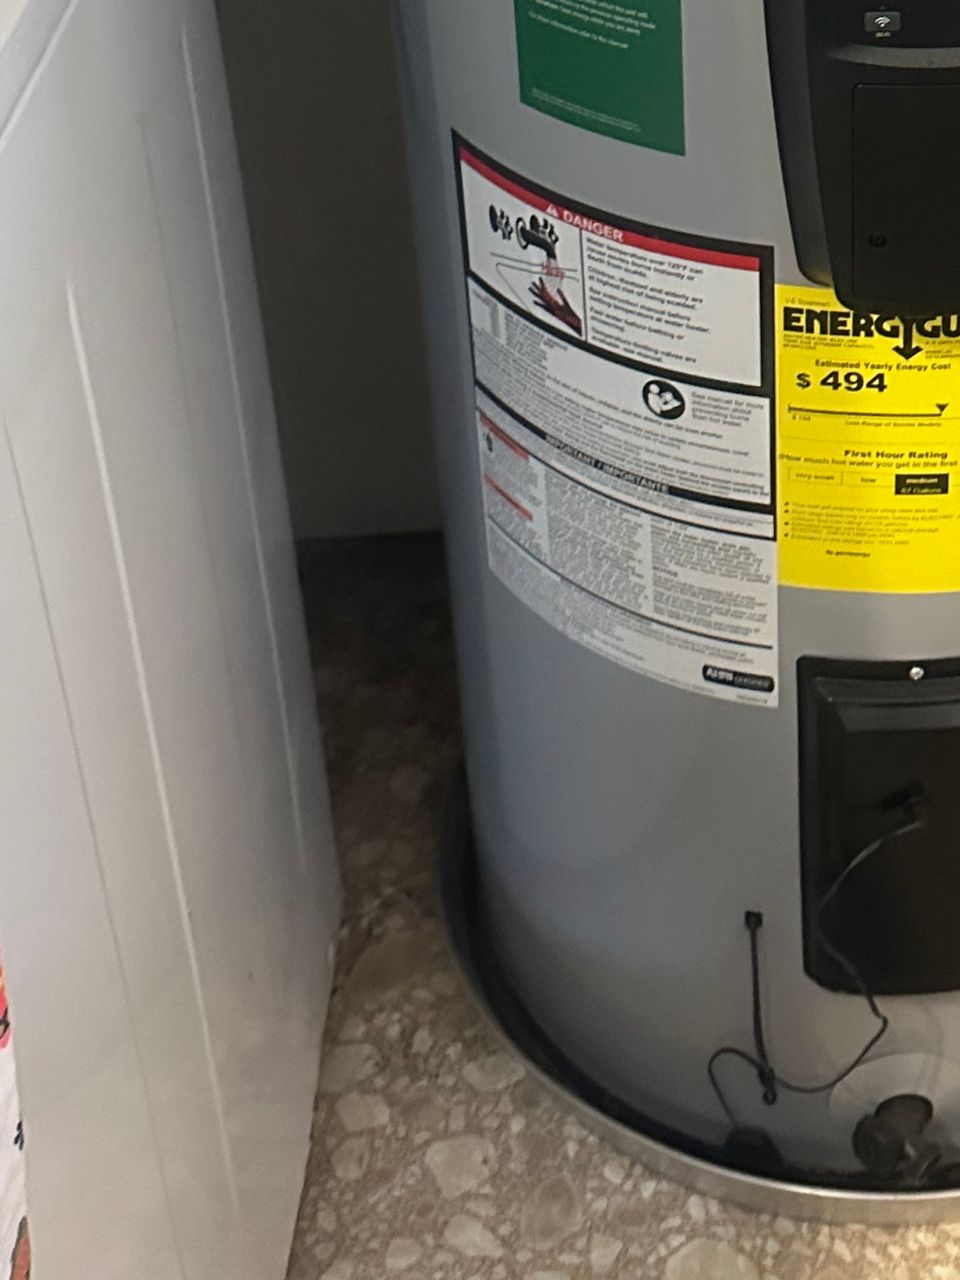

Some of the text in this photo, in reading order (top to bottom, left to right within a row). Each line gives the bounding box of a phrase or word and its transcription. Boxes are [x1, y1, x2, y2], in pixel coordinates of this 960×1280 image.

[562, 208, 624, 243] DANGER
[815, 358, 952, 373] Estimated Yearly Energy Cost
[796, 370, 888, 393] $ 494
[844, 449, 948, 461] First Hour Rating
[804, 456, 830, 465] much
[831, 457, 847, 466] hot
[849, 459, 874, 468] water
[876, 460, 893, 469] you
[895, 460, 910, 470] get
[912, 460, 921, 468] in
[922, 460, 938, 468] the
[939, 459, 958, 468] first
[860, 476, 878, 484] low
[905, 476, 940, 485] medium
